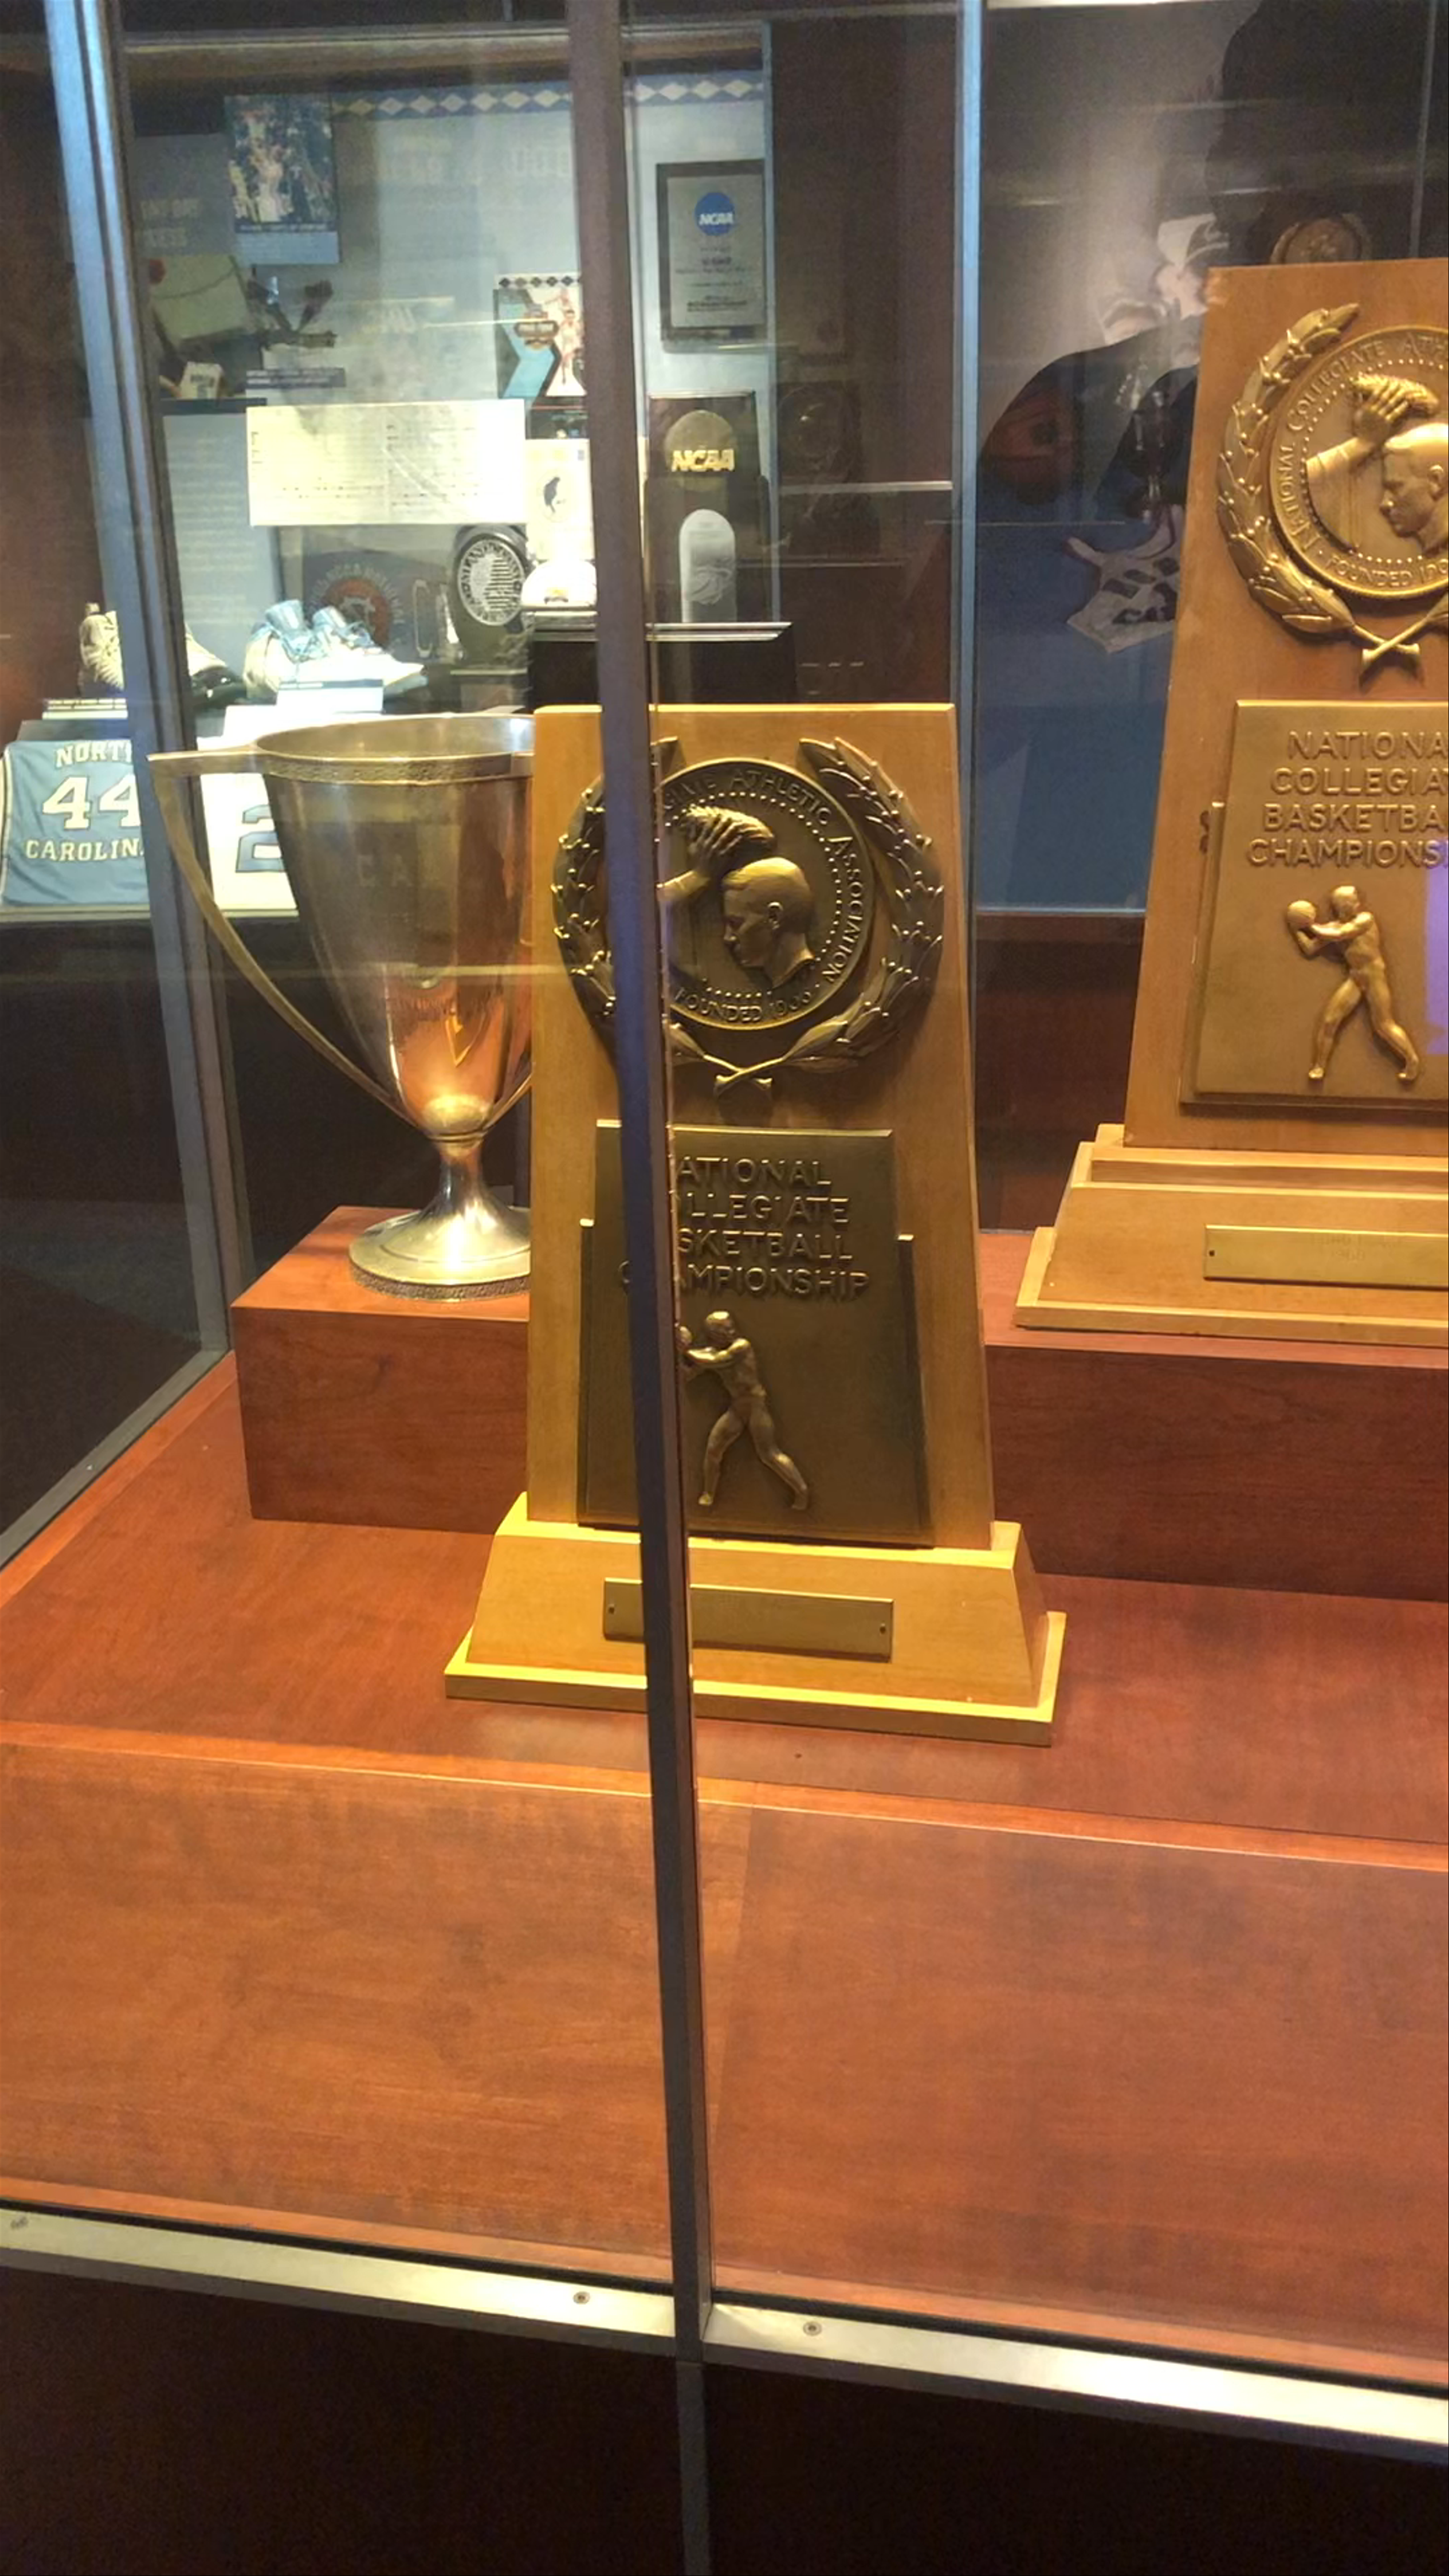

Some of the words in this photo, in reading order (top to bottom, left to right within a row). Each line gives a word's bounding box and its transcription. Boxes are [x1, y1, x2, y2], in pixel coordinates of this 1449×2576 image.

[672, 448, 735, 472] NCAA
[1325, 553, 1412, 586] FOUNDED
[1271, 767, 1448, 796] COLLEGIA
[42, 773, 142, 830] 44
[25, 837, 144, 861] CAROLIN
[1247, 838, 1448, 867] CHAMPIONS
[728, 768, 832, 826] ATHLETIC
[821, 835, 864, 983] ASSOCIATION
[675, 987, 762, 1021] FOUNDED
[677, 1157, 832, 1186] ATIONAL
[675, 1192, 849, 1223] LLEGIATE
[677, 1227, 853, 1260] SKETBALL
